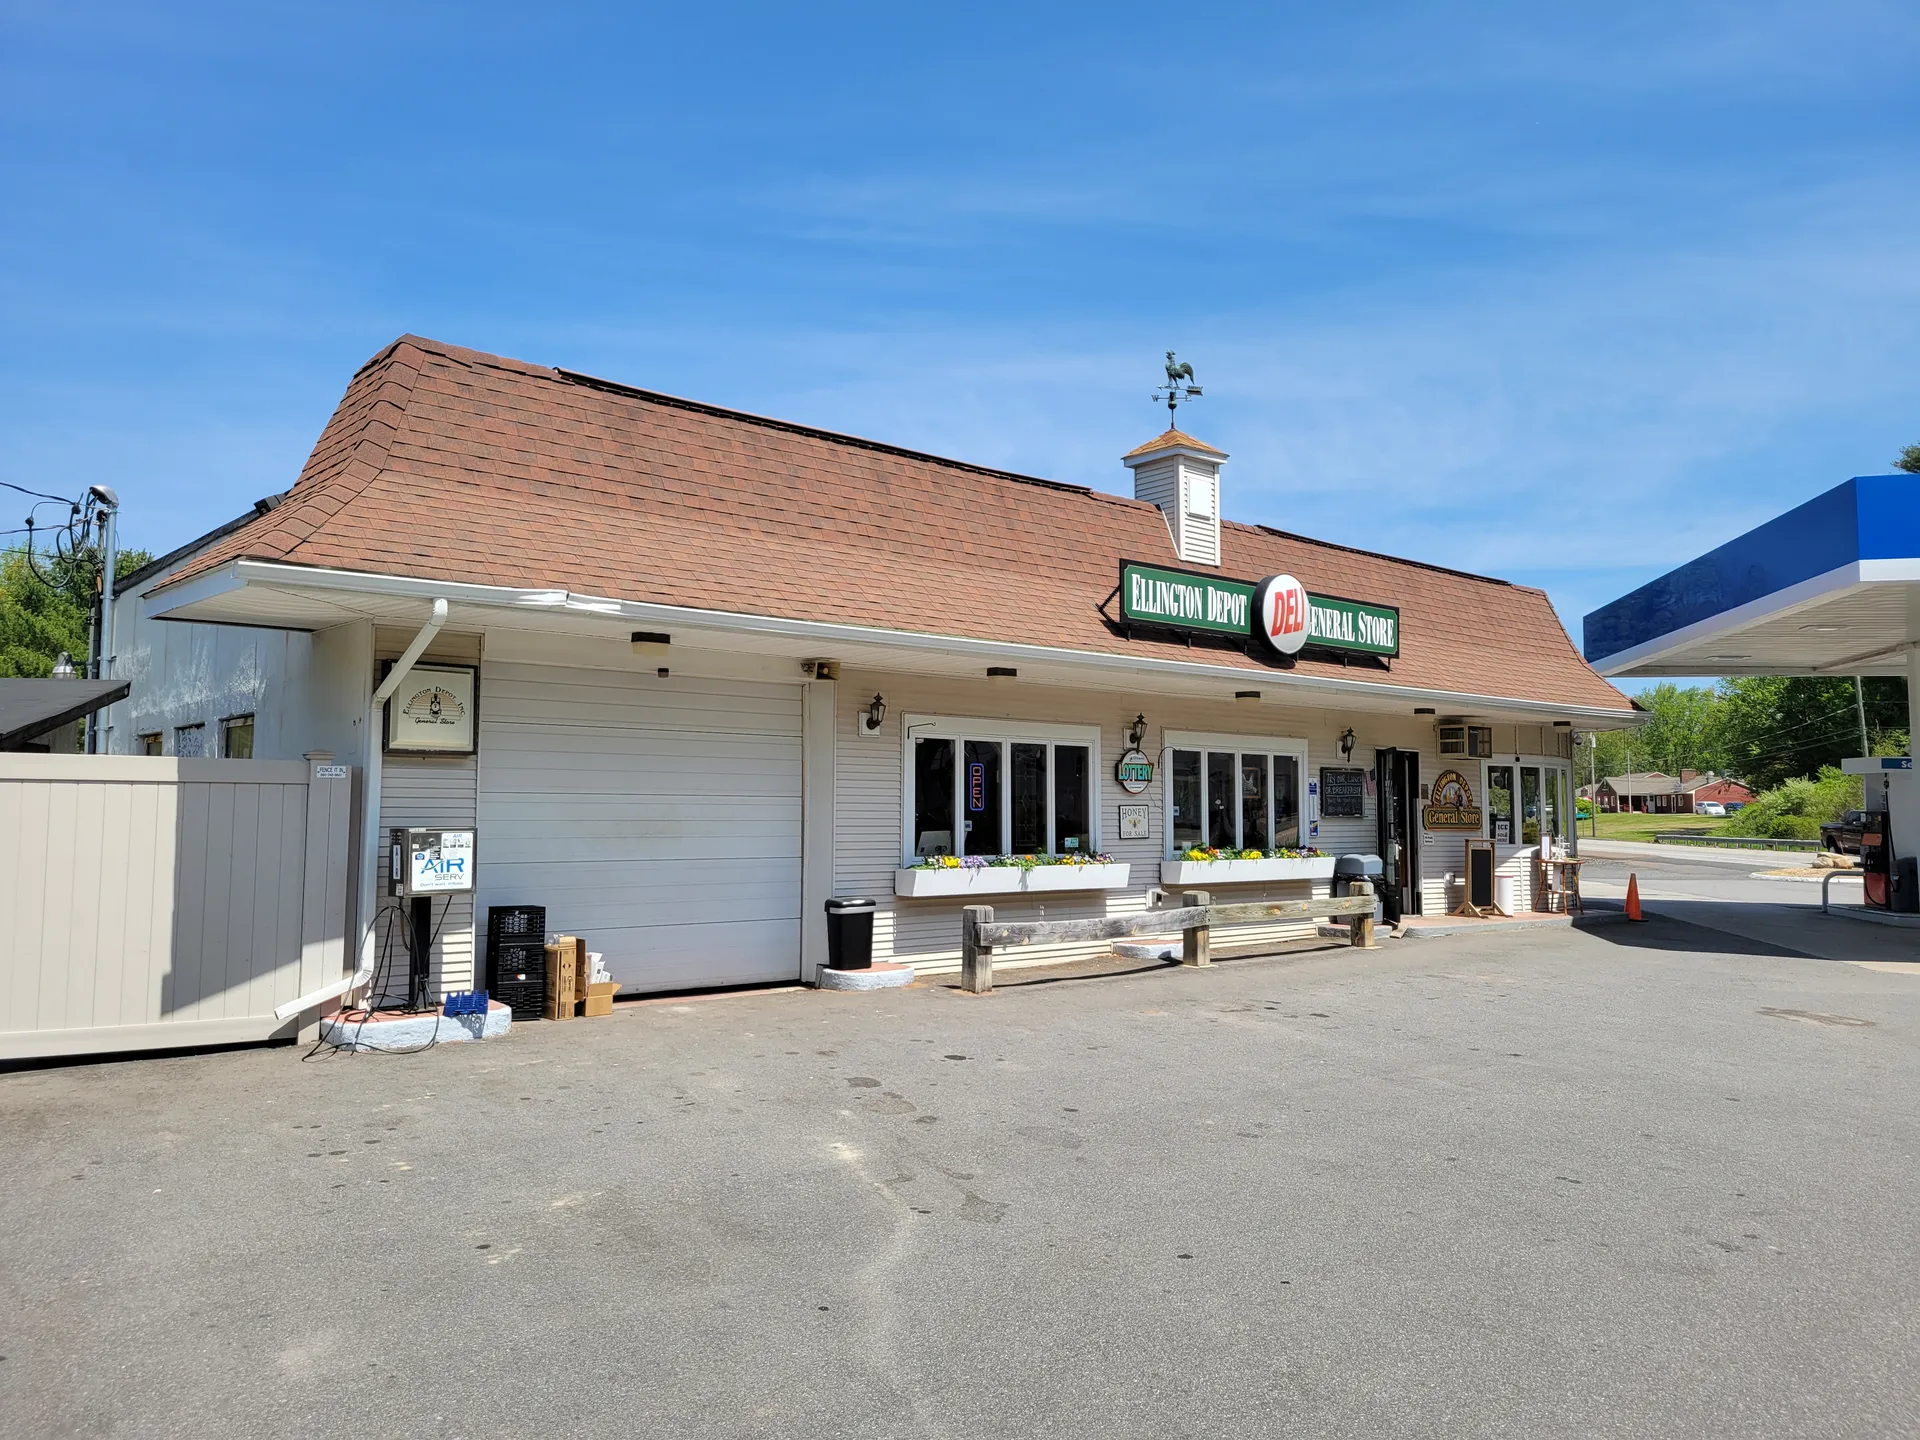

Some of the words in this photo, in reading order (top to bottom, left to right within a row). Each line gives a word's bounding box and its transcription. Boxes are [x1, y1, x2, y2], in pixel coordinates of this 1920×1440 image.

[1131, 573, 1203, 620] ELLINGTON
[1207, 586, 1247, 626] DEPOT
[1271, 586, 1305, 637] DELI
[1358, 611, 1394, 647] STORE
[1118, 764, 1153, 781] LOTTERY
[972, 766, 982, 808] OPEN
[1459, 777, 1473, 801] DEPOT
[1122, 807, 1147, 820] HONEY
[1428, 810, 1458, 824] General
[1460, 811, 1479, 824] Store
[435, 873, 464, 881] SERV
